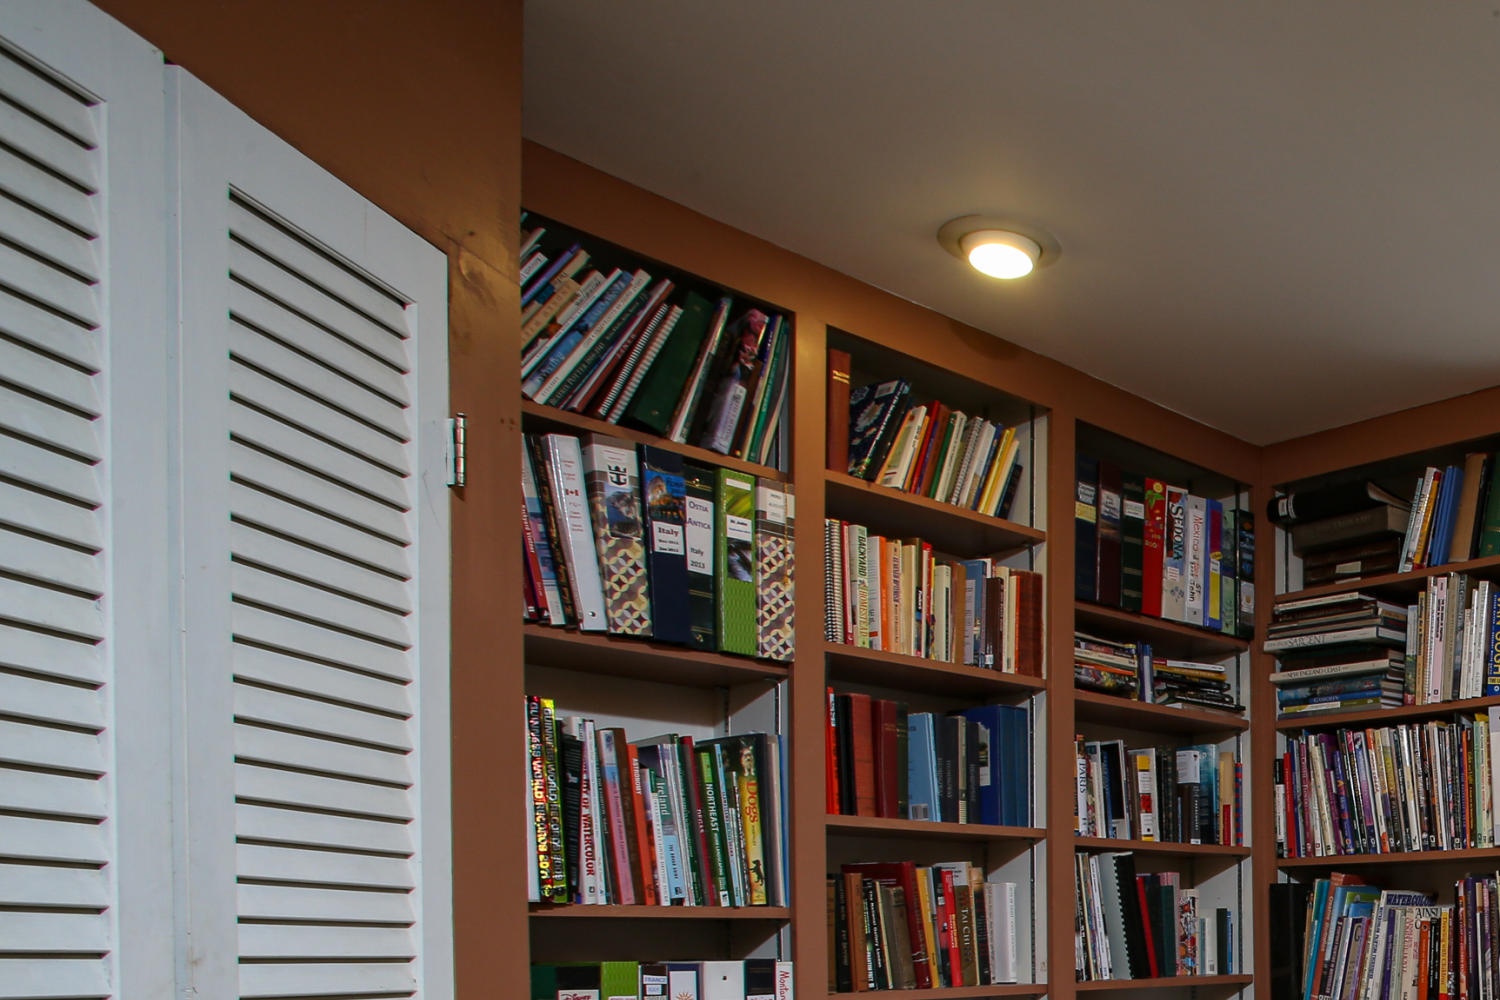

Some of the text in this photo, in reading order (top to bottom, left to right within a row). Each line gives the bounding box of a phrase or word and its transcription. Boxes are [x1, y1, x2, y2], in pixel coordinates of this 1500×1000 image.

[517, 504, 536, 532] Backyard
[688, 500, 708, 513] OSTIA
[688, 517, 711, 531] ANTICA
[657, 526, 679, 538] Italy
[1170, 504, 1182, 560] SEDONA
[1193, 515, 1202, 552] Mexico
[690, 546, 704, 557] Italy
[856, 535, 869, 637] BACKYARD HOMESTEAD
[1287, 634, 1326, 648] SARGENT
[1299, 668, 1325, 677] ENGLAND
[1324, 666, 1341, 674] COAST
[541, 708, 556, 762] GUINNESS
[527, 701, 549, 852] GUINNESS WORLD RECORDS
[546, 763, 558, 801] WORLD
[630, 757, 642, 795] ASTRONOMY
[1078, 762, 1088, 793] PARIS
[581, 797, 590, 810] OF
[656, 781, 671, 816] Ireland
[741, 780, 761, 824] Dogs
[548, 803, 562, 851] RECORDS
[705, 783, 719, 832] NORTHEAST
[715, 846, 724, 876] LANDSCAPING
[581, 814, 596, 876] WATERCOLOR
[669, 853, 677, 867] ROUGH
[872, 927, 880, 947] Gallery
[961, 908, 971, 945] TAI CHI
[1440, 917, 1448, 942] Drawing
